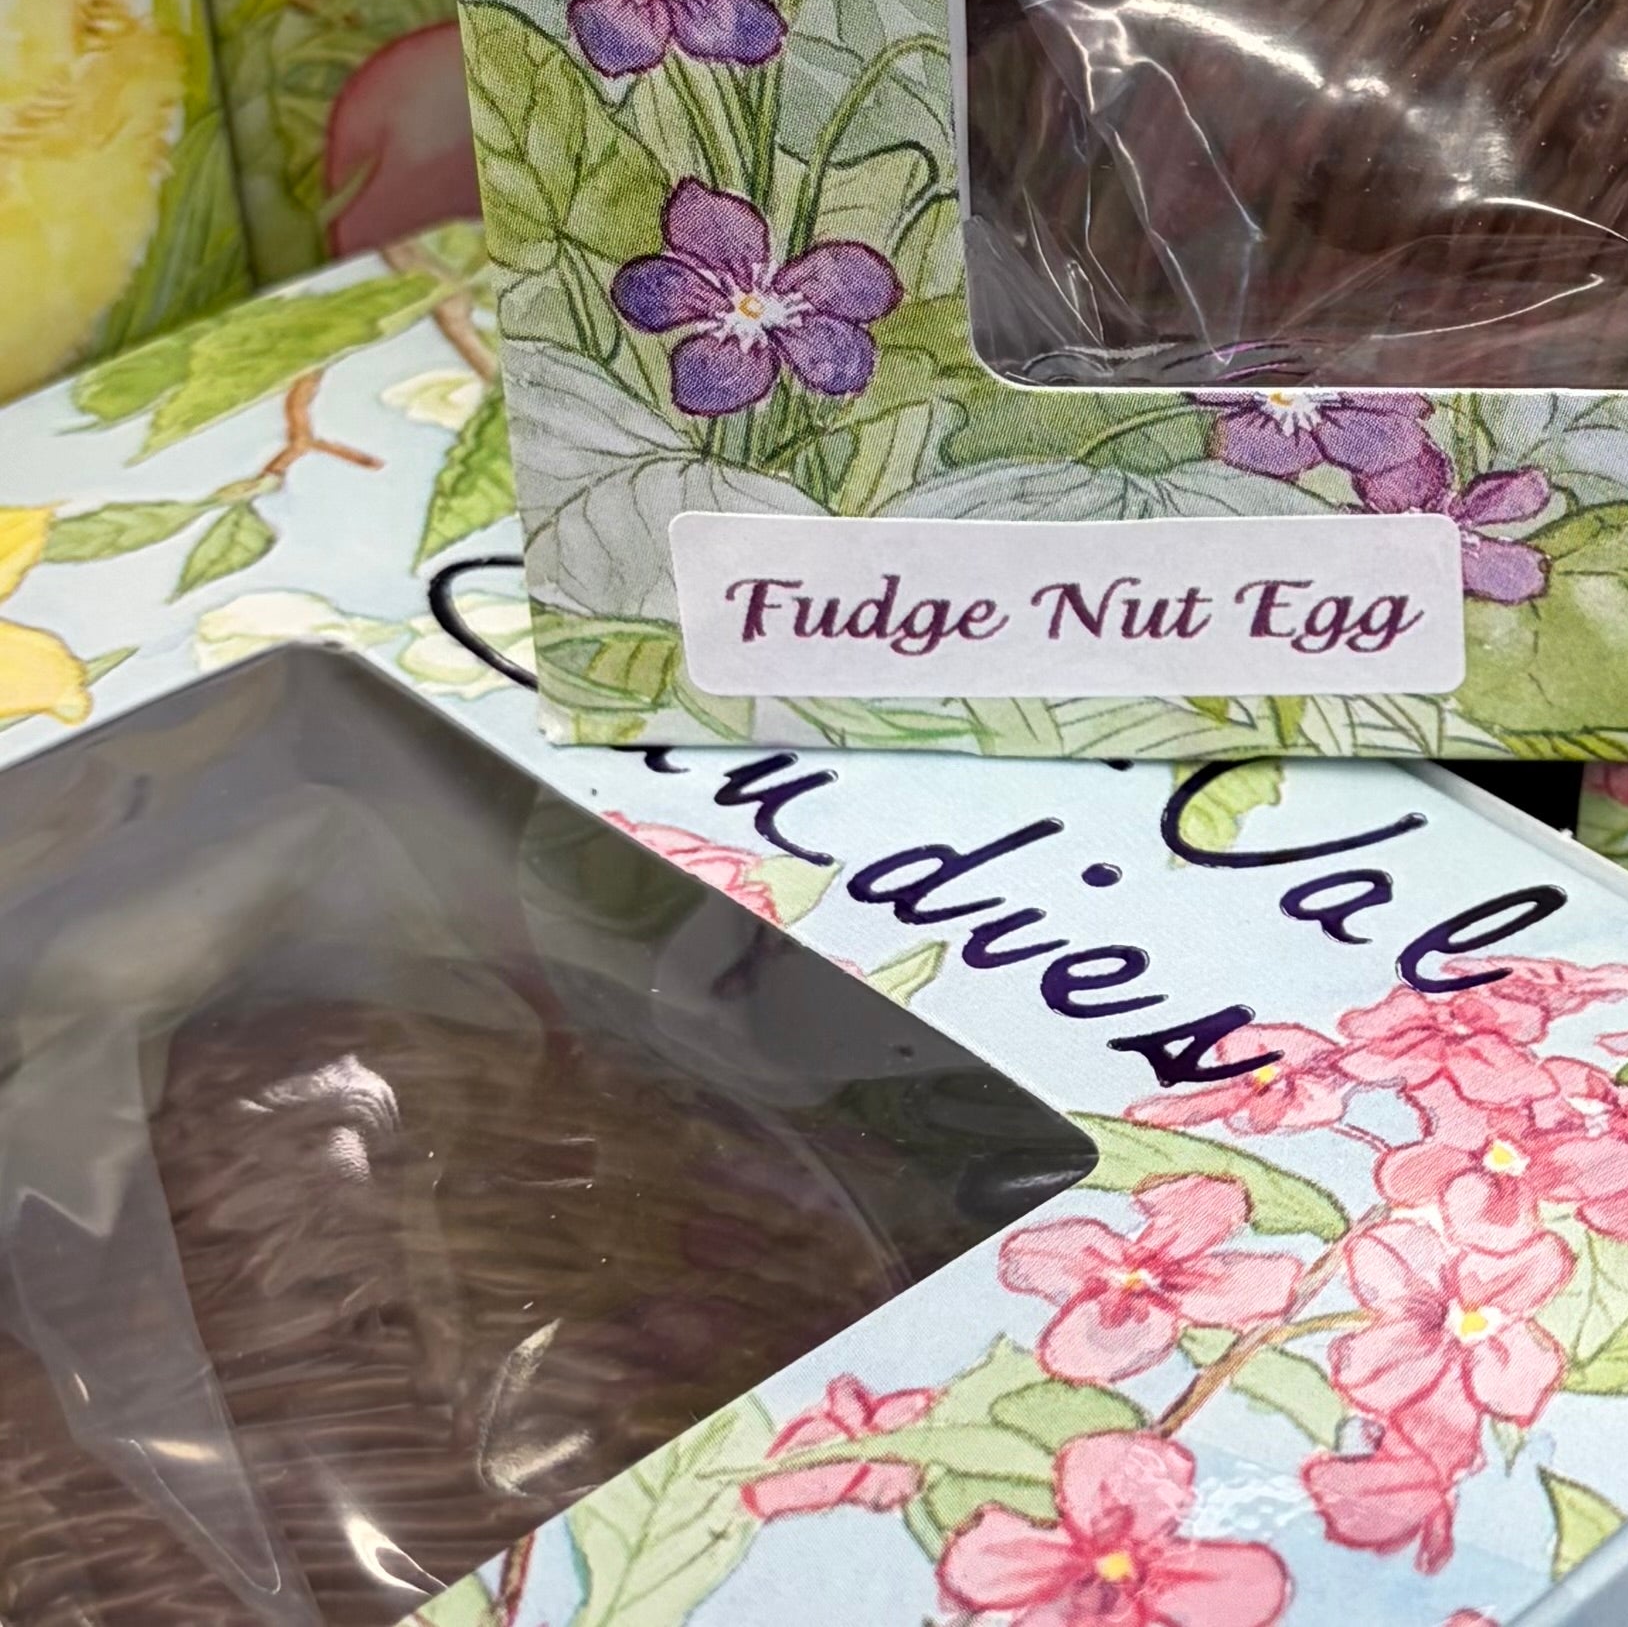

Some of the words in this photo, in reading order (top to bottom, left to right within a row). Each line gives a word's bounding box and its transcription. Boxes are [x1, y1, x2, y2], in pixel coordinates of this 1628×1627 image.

[726, 573, 1010, 657] Fudge
[1030, 576, 1213, 640] Nut
[1234, 578, 1425, 654] Egg
